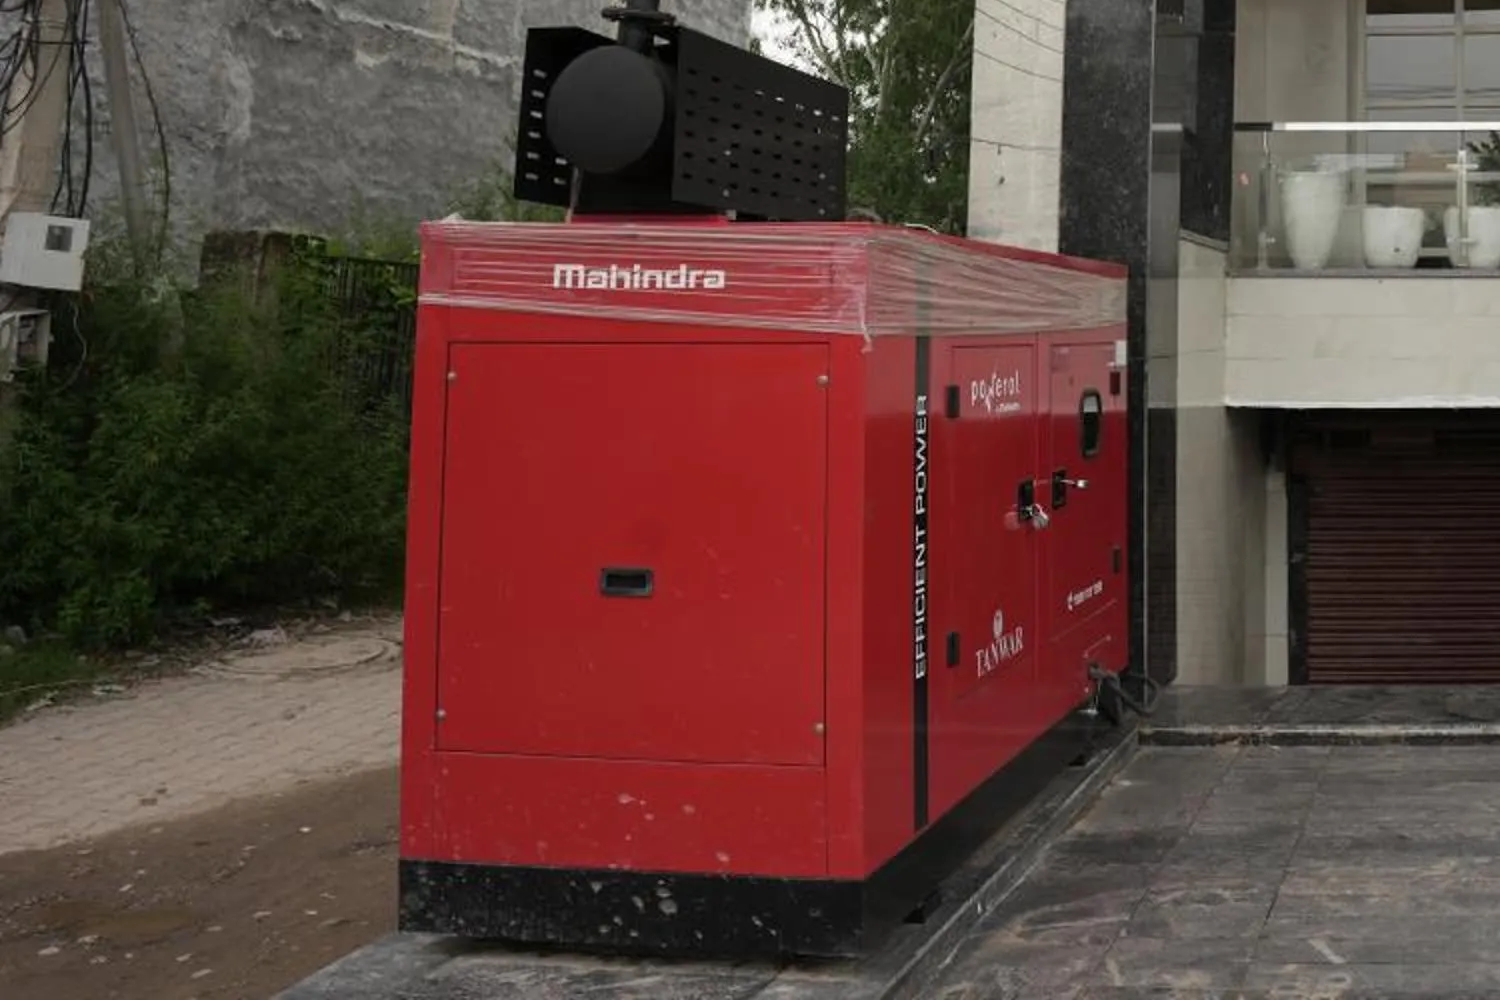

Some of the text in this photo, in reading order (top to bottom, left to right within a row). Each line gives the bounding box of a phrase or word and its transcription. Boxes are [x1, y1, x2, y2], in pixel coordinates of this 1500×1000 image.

[553, 263, 726, 289] Mahindra
[914, 394, 928, 680] EFFICIENT POWER
[975, 627, 1024, 678] TANWAR
